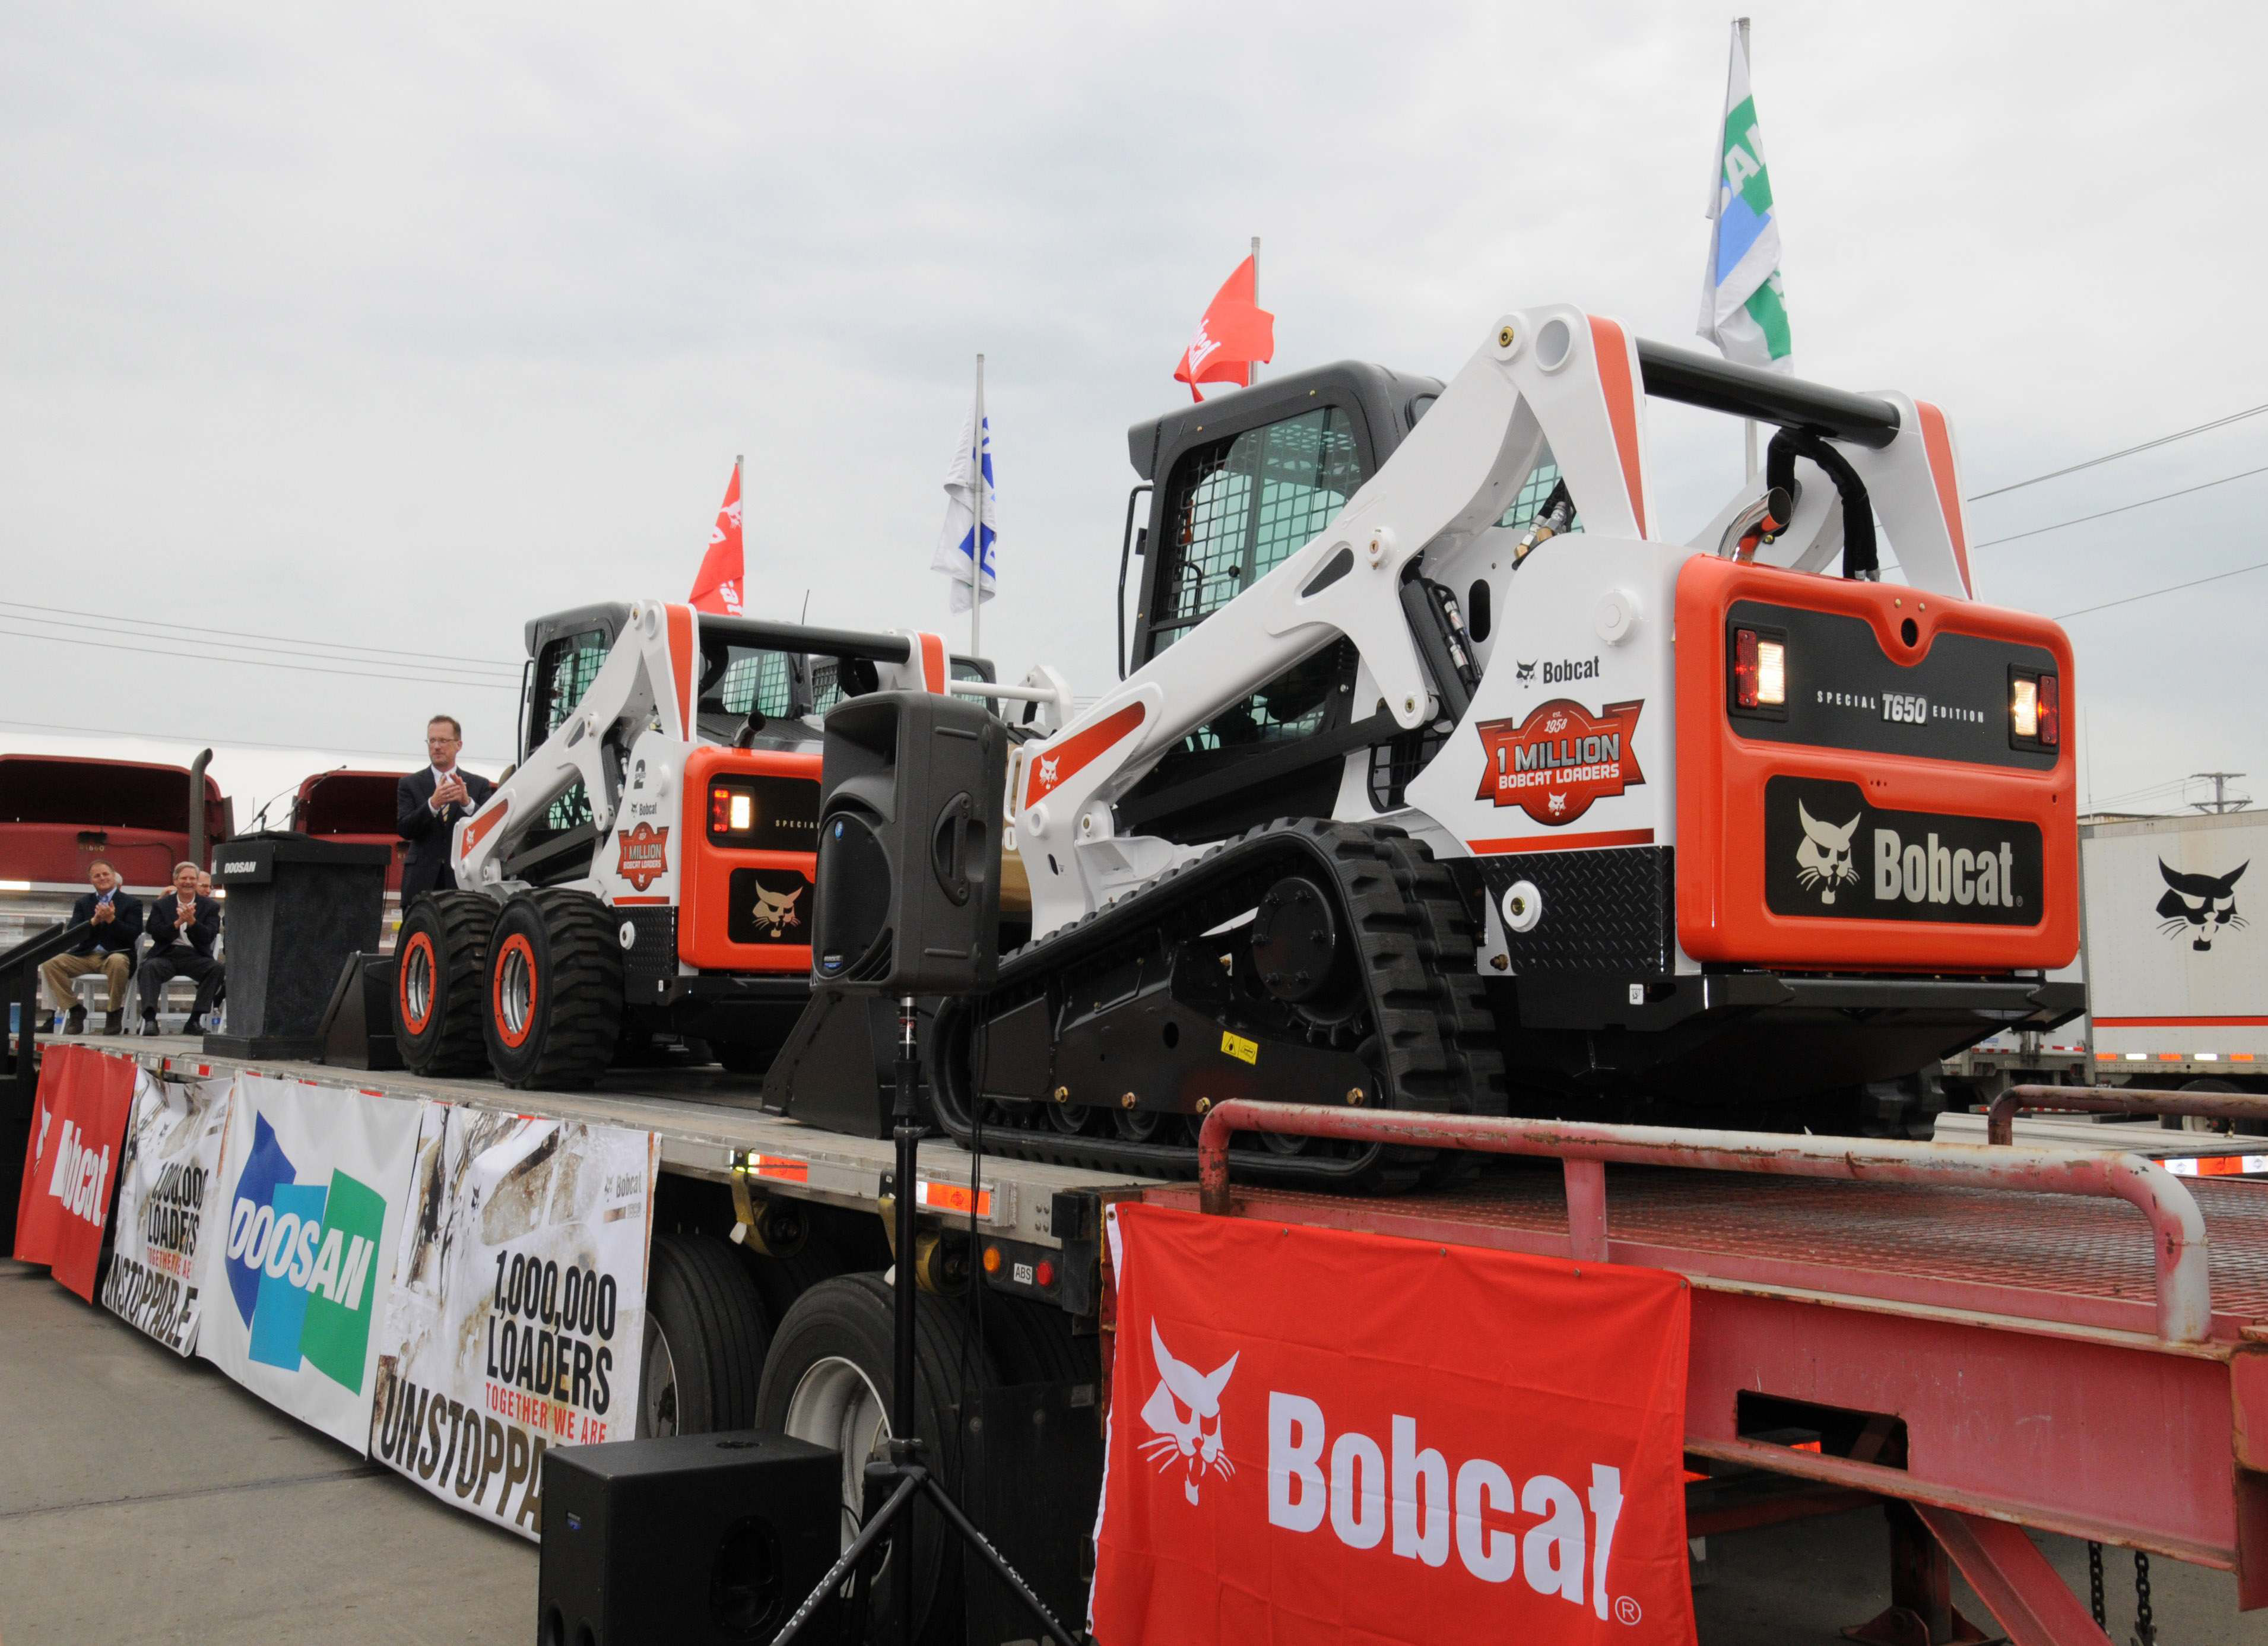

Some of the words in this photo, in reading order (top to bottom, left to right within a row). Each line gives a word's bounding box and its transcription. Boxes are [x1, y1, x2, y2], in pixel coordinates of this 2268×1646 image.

[1543, 655, 1599, 684] Bobcat
[1817, 690, 1876, 709] SPECIAL
[1882, 693, 1927, 724] T650
[1933, 705, 1984, 724] EDITION
[1544, 718, 1568, 734] 1958
[1497, 747, 1506, 773] 1
[1515, 732, 1620, 772] MILLION
[1499, 770, 1552, 789] BOBCAT
[1556, 763, 1619, 784] LOADERS
[639, 802, 657, 816] Bobcat
[623, 845, 627, 860] 1
[629, 843, 662, 860] MILLION
[224, 861, 256, 873] DOOSAN
[616, 1171, 642, 1198] Bobcat
[227, 1197, 375, 1311] DOOSAN
[1016, 1266, 1031, 1280] ABS
[494, 1249, 617, 1341] 1,000,000
[487, 1315, 613, 1416] LOADERS
[486, 1382, 548, 1431] TOGETHER
[554, 1406, 575, 1439] WE
[381, 1374, 552, 1535] UNSTOPPA
